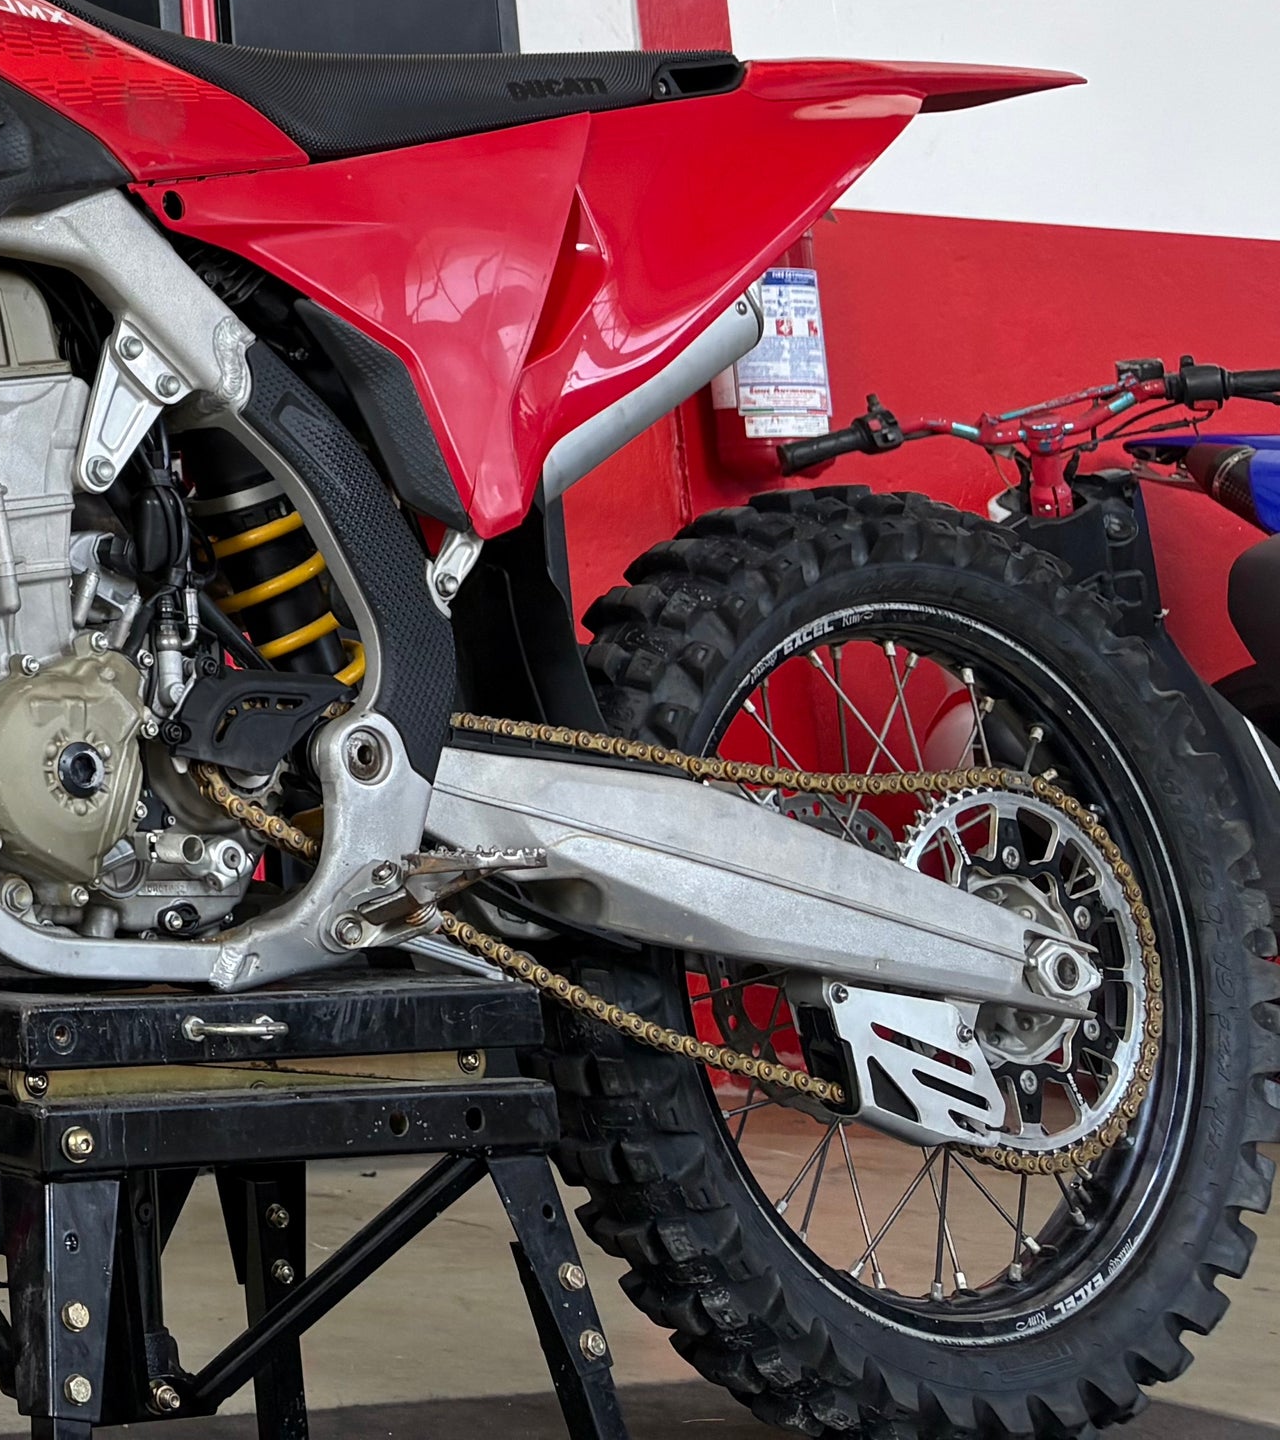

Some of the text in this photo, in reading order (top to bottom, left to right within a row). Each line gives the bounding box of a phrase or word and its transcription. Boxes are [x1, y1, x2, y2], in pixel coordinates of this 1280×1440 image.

[506, 76, 609, 101] DUCATI
[782, 621, 835, 656] EXCEL
[1053, 1271, 1105, 1315] EXCEL
